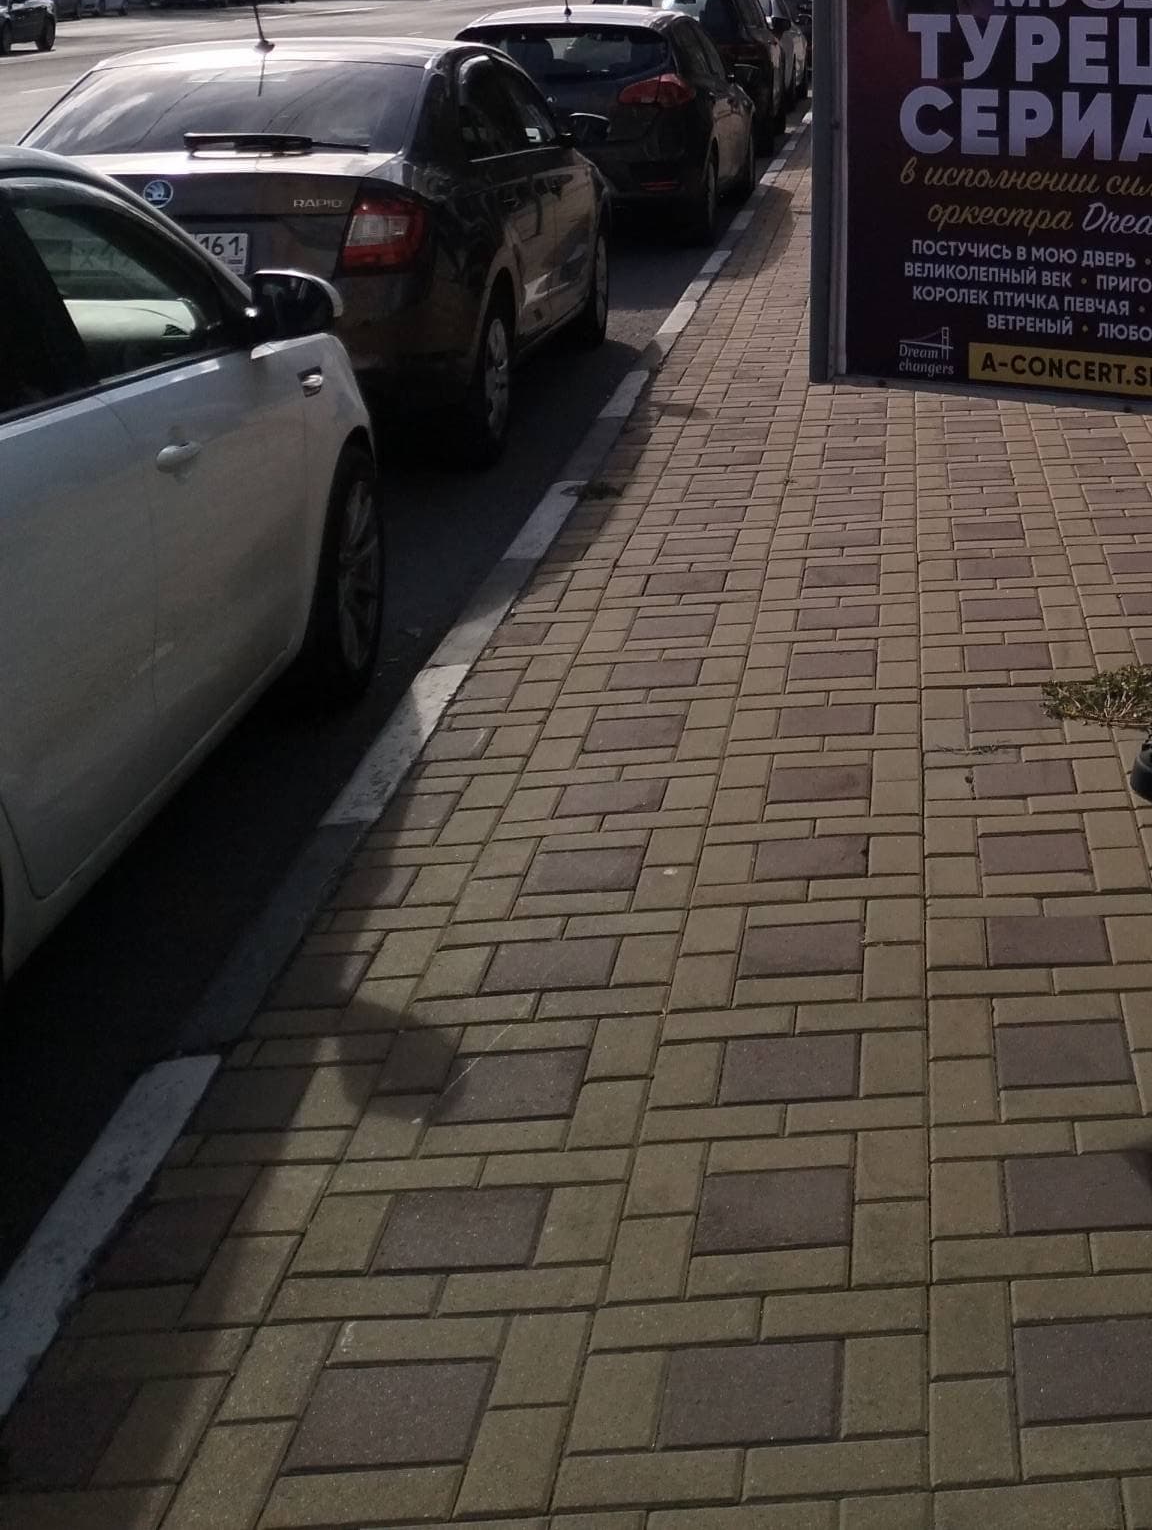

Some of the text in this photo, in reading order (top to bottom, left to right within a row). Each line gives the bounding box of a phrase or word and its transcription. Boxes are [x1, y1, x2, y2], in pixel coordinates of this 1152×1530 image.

[900, 157, 916, 184] в
[925, 161, 1098, 193] исполнении
[293, 199, 343, 208] RAPID
[927, 203, 1072, 237] оркестра
[912, 239, 1012, 261] ПОСТУЧИСЬ
[1017, 246, 1027, 261] В
[1031, 246, 1077, 265] МОЮ
[1082, 249, 1136, 268] ДВЕРЬ
[905, 262, 1037, 287] ВЕЛИКОЛЕПНЫЙ
[1042, 271, 1072, 288] ВЕК
[913, 285, 989, 306] КОРОЛЕК
[993, 289, 1059, 311] ПТИЧКА
[1064, 295, 1130, 316] ПЕВЧАЯ
[987, 314, 1073, 336] ВЕТРЕНЫЙ
[899, 344, 938, 359] Dream
[899, 358, 954, 377] changers
